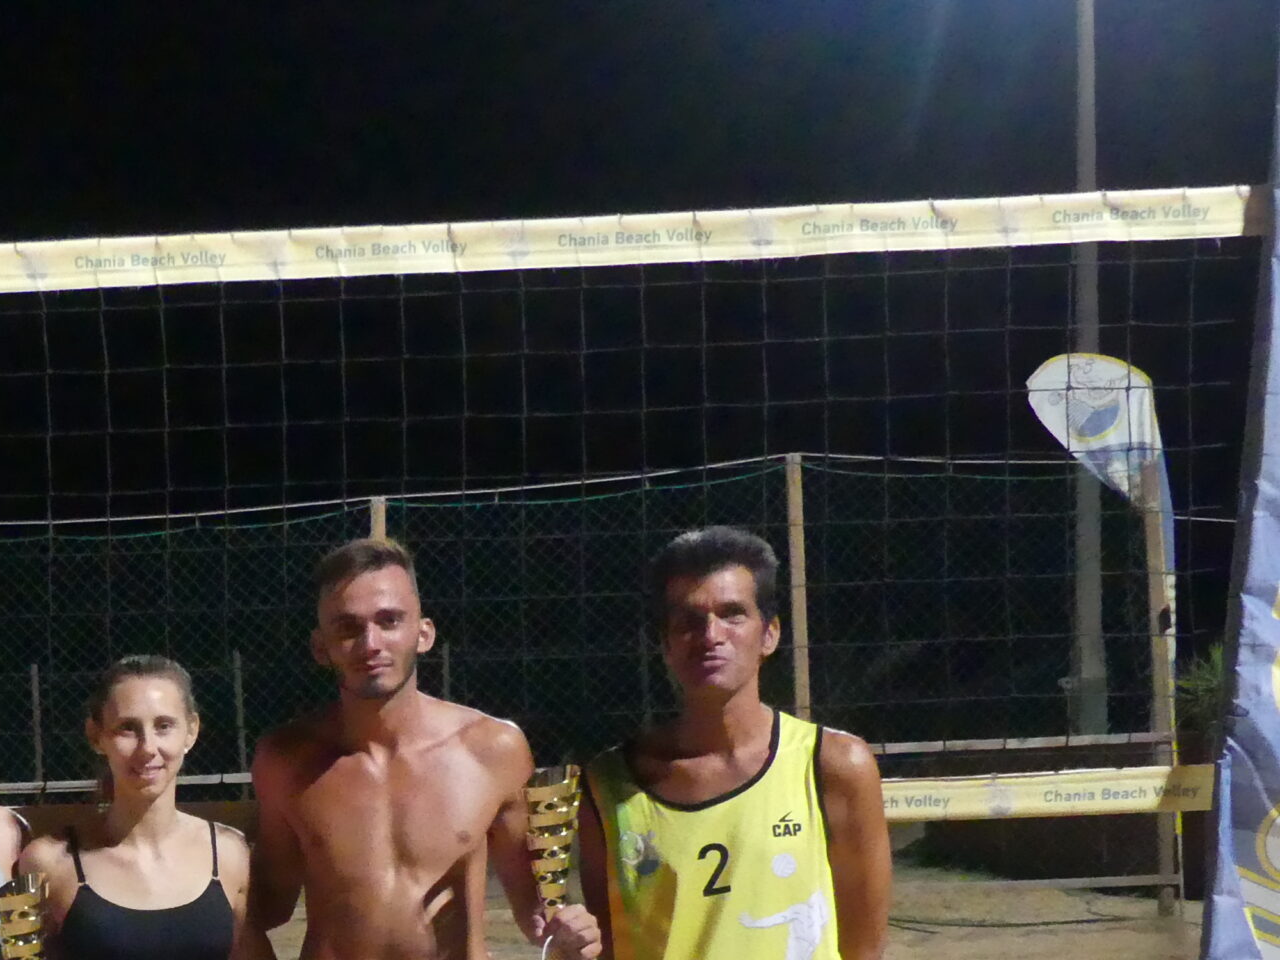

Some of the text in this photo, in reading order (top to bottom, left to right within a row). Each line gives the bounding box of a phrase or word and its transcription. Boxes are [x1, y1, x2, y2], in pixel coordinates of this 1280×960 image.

[1051, 204, 1210, 224] Chania Beach Volley
[801, 216, 958, 236] Chania Beach Volley
[558, 229, 712, 247] Chania Beach Volley
[315, 240, 467, 259] Chania Beach Volley
[74, 251, 226, 269] Chania Beach Volley
[904, 794, 950, 809] Volley
[1043, 784, 1199, 803] Chania Beach Volley
[772, 823, 802, 837] CAP
[697, 843, 731, 897] 2
